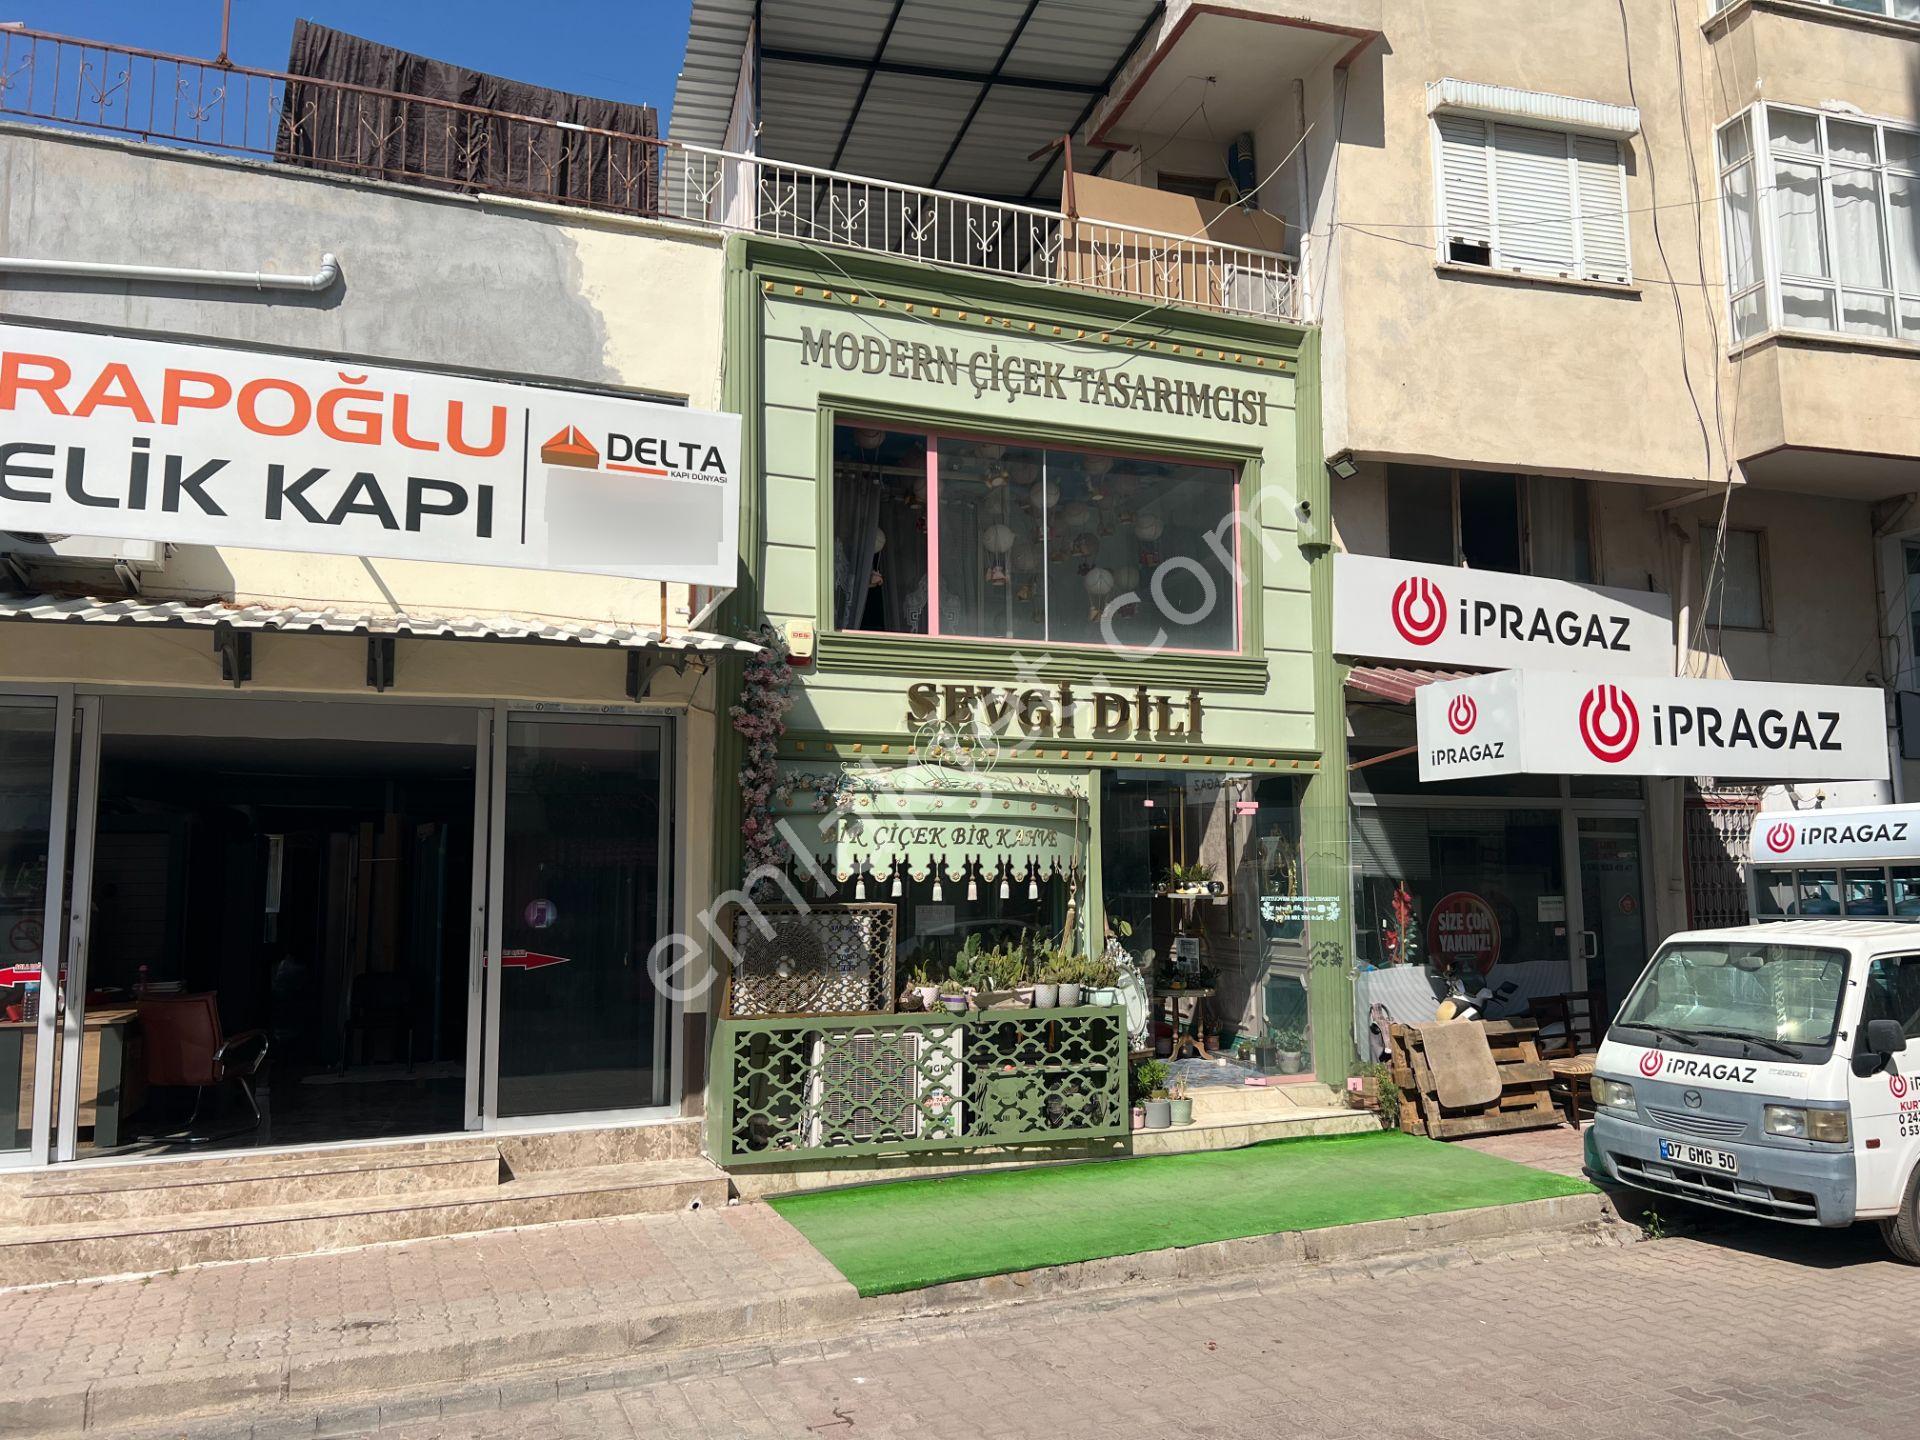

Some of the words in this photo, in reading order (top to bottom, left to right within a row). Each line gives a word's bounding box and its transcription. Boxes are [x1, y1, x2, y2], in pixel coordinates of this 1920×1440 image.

[800, 326, 959, 385] MODERN
[968, 345, 1067, 402] ÇİÇEK
[1073, 365, 1269, 426] TASARIMCISI
[0, 351, 507, 457] RAPOĞLU
[607, 433, 727, 474] DELTA
[671, 471, 690, 479] KAPI
[691, 472, 727, 484] DÜNYASI
[265, 463, 494, 538] KAPI
[907, 680, 1076, 733] SEVGİ
[1091, 684, 1204, 738] DİLİ
[873, 823, 947, 850] ÇİÇEK
[951, 824, 993, 849] BİR
[996, 827, 1058, 849] KAHVE
[1438, 910, 1464, 931] SİZE
[1466, 912, 1490, 933] ÇOK
[1439, 933, 1491, 953] YAKINIZ!
[1667, 1142, 1682, 1158] 07
[1688, 1147, 1713, 1165] GMG
[1718, 1153, 1735, 1170] 50
